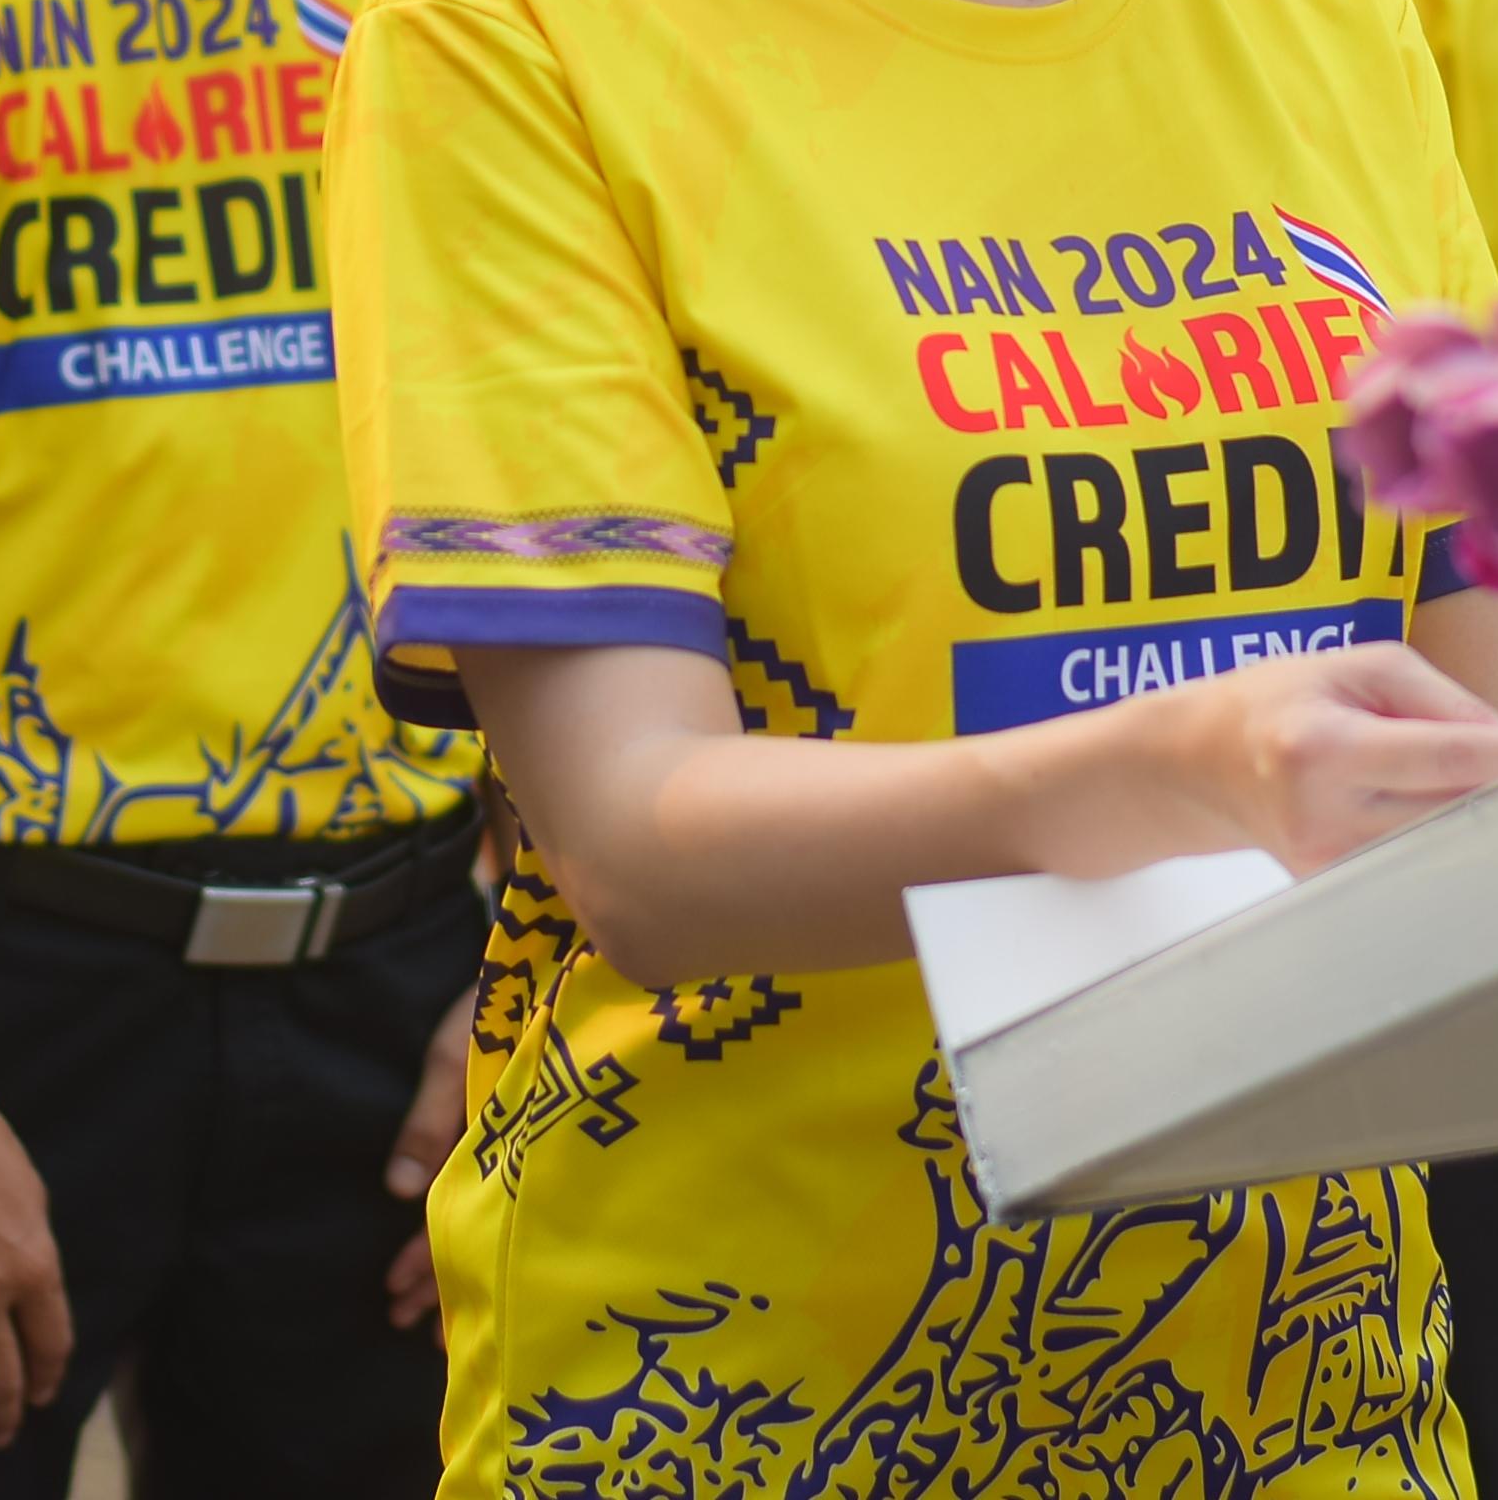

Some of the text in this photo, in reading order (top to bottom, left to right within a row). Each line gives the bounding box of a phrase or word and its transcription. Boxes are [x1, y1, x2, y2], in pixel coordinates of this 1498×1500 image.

[873, 210, 1287, 317] NAN 2024
[58, 322, 326, 391] CHALLENGE
[952, 426, 1404, 615] CREDI
